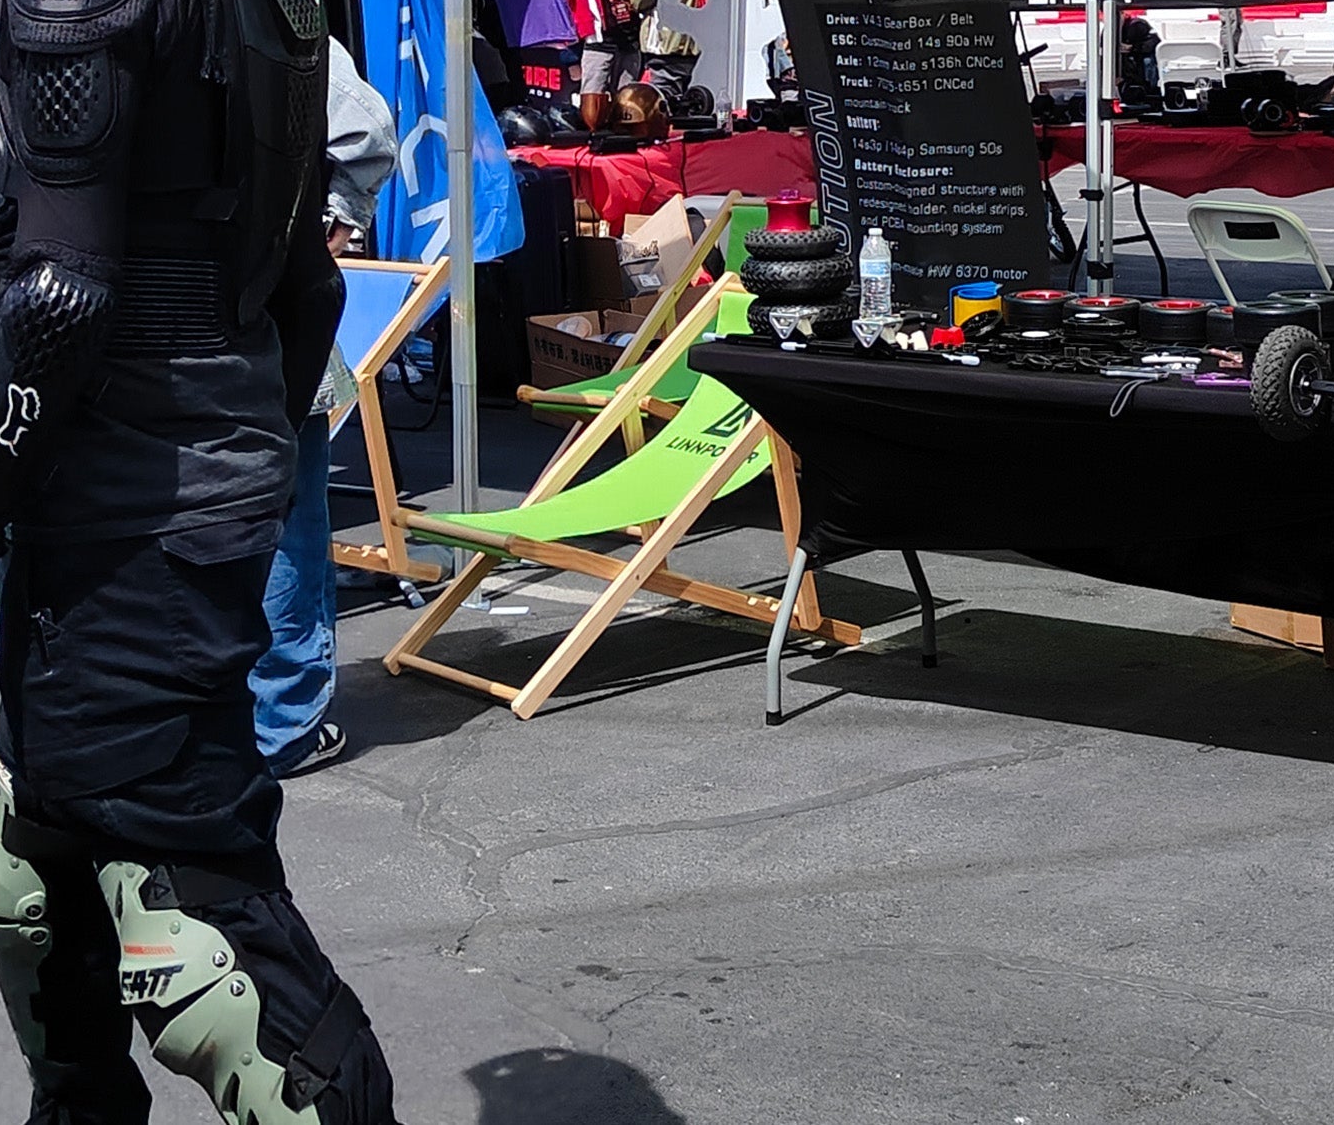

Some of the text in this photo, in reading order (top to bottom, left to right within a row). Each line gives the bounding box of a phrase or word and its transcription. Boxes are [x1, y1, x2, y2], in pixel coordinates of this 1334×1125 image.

[826, 13, 859, 25] Drive:
[884, 16, 932, 29] GearBox
[950, 13, 974, 25] Belt
[831, 34, 857, 46] ESC:
[974, 35, 995, 46] HW
[965, 56, 1004, 69] CNCed
[934, 77, 974, 90] CNCed
[919, 143, 975, 157] Samsung
[979, 141, 1003, 156] 50s
[854, 158, 893, 174] Battery
[940, 183, 997, 197] structure
[999, 183, 1025, 197] with
[953, 201, 987, 215] nickel
[989, 203, 1028, 218] strips,
[961, 222, 1005, 236] system
[955, 265, 989, 279] 6370
[992, 266, 1028, 280] motor
